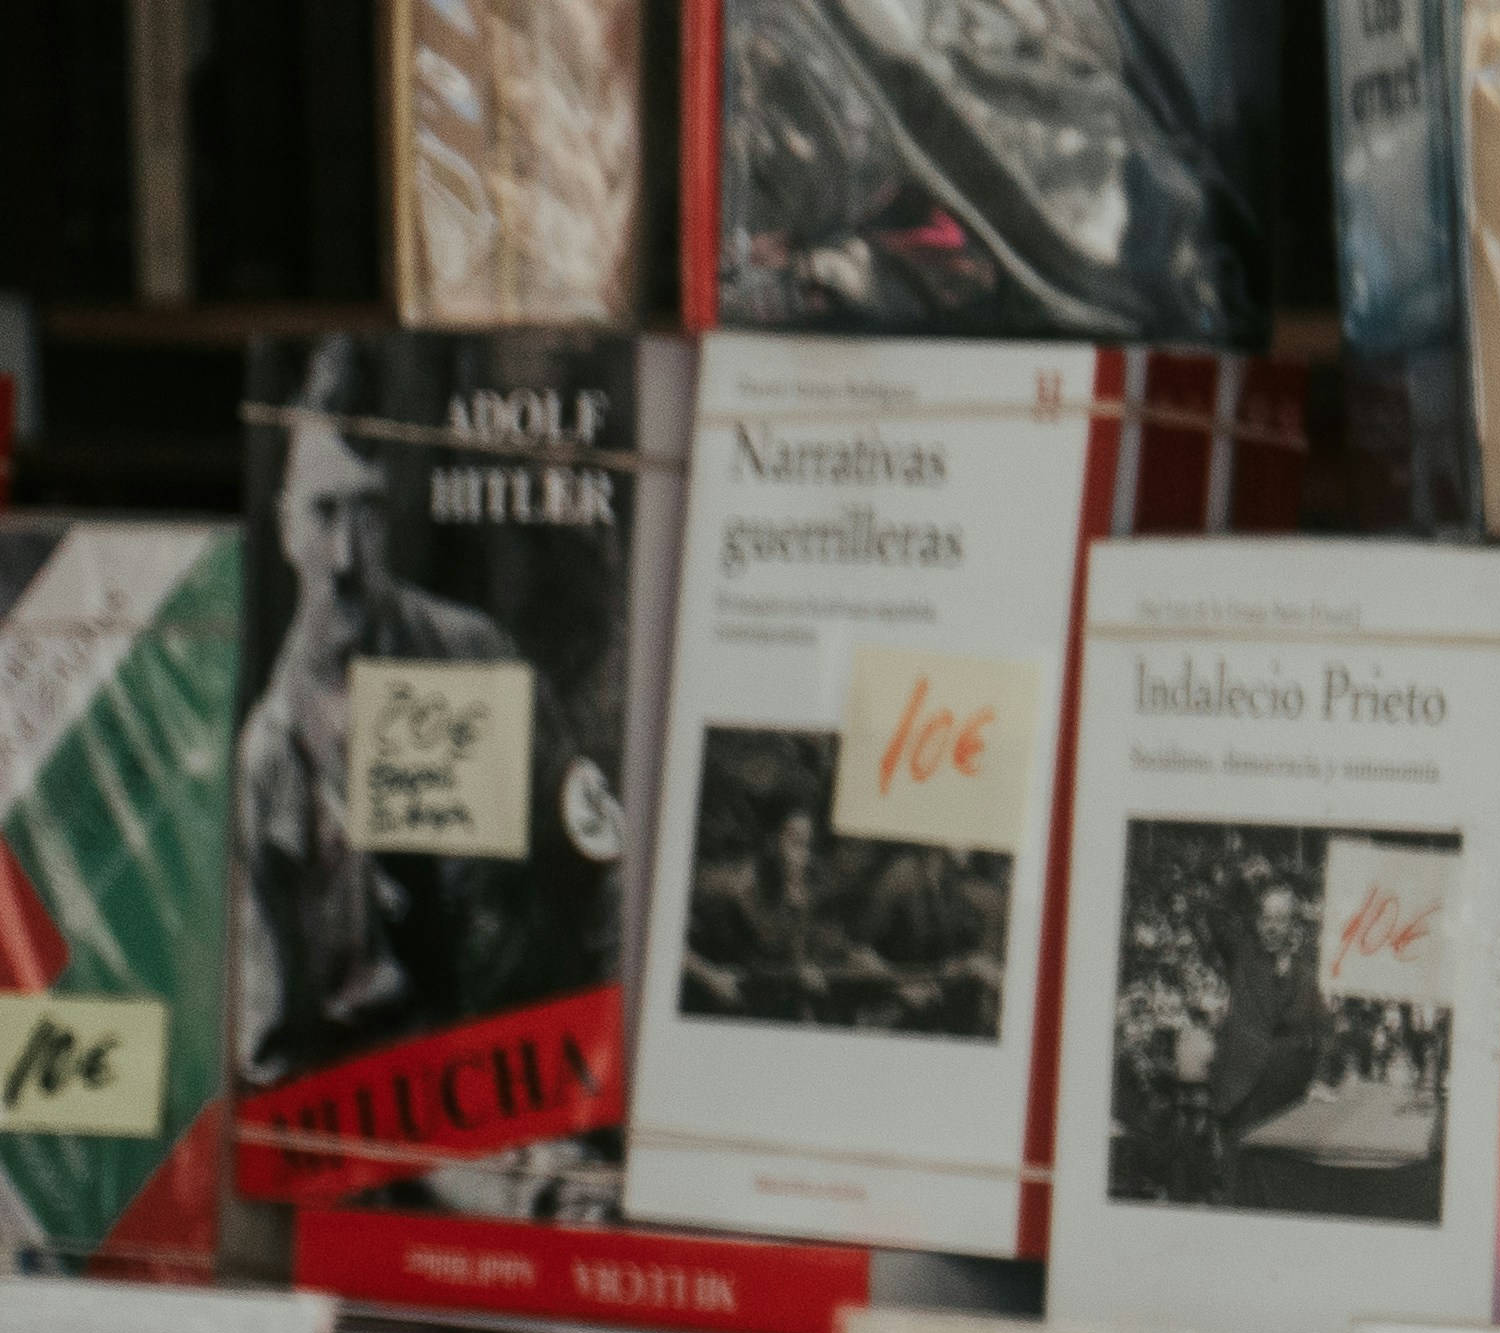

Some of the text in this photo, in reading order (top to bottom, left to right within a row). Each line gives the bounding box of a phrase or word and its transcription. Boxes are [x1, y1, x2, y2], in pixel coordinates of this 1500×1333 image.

[444, 388, 608, 452] ADOLF
[730, 417, 948, 488] Narrativas
[430, 468, 617, 526] HITLER
[720, 502, 964, 580] guerrilleras
[1133, 654, 1448, 727] Indalecio Prieto
[354, 1030, 598, 1145] LUCHA
